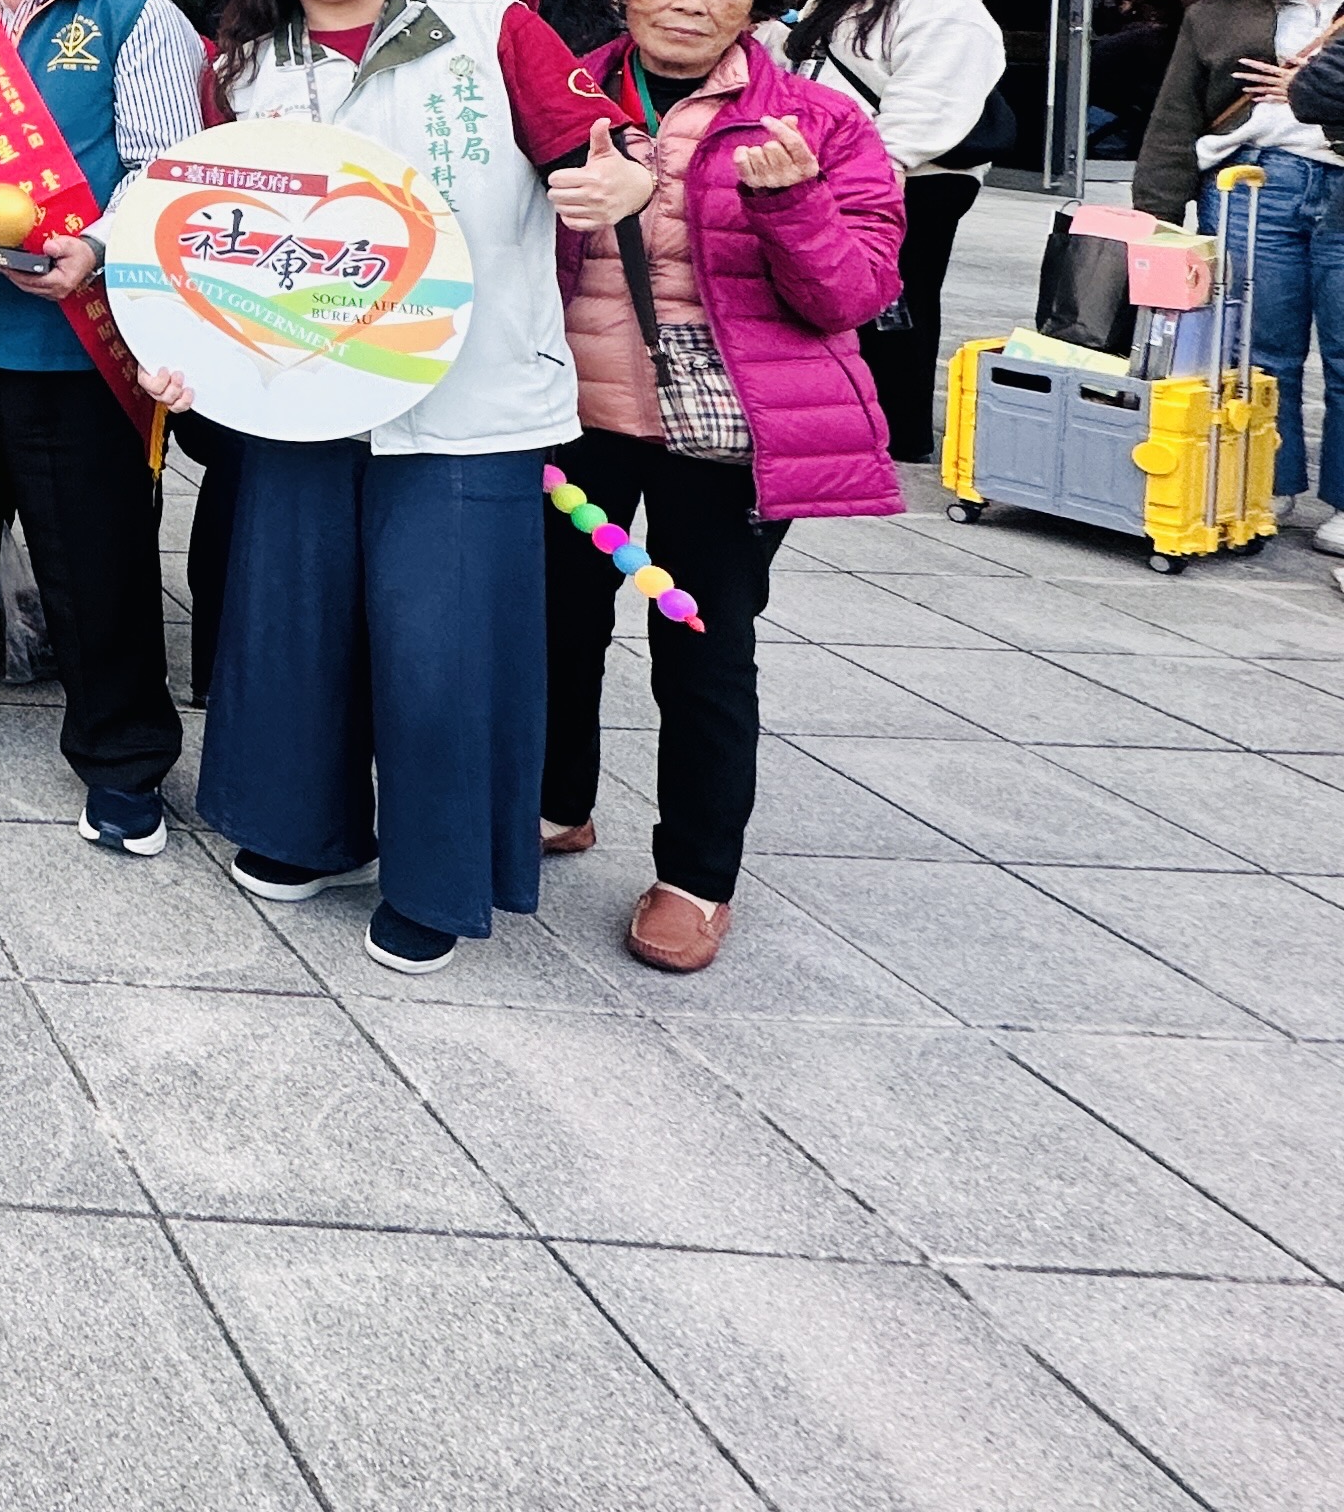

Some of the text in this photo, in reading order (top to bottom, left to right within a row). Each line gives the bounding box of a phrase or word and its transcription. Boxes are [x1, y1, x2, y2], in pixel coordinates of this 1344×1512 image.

[452, 76, 490, 165] 社會局
[184, 164, 289, 193] 臺南市政府
[179, 208, 387, 291] 社會局
[116, 269, 351, 358] TAINAN CITY GOVERNMENT
[311, 292, 364, 309] SOCIAL
[311, 308, 373, 325] BUREAU
